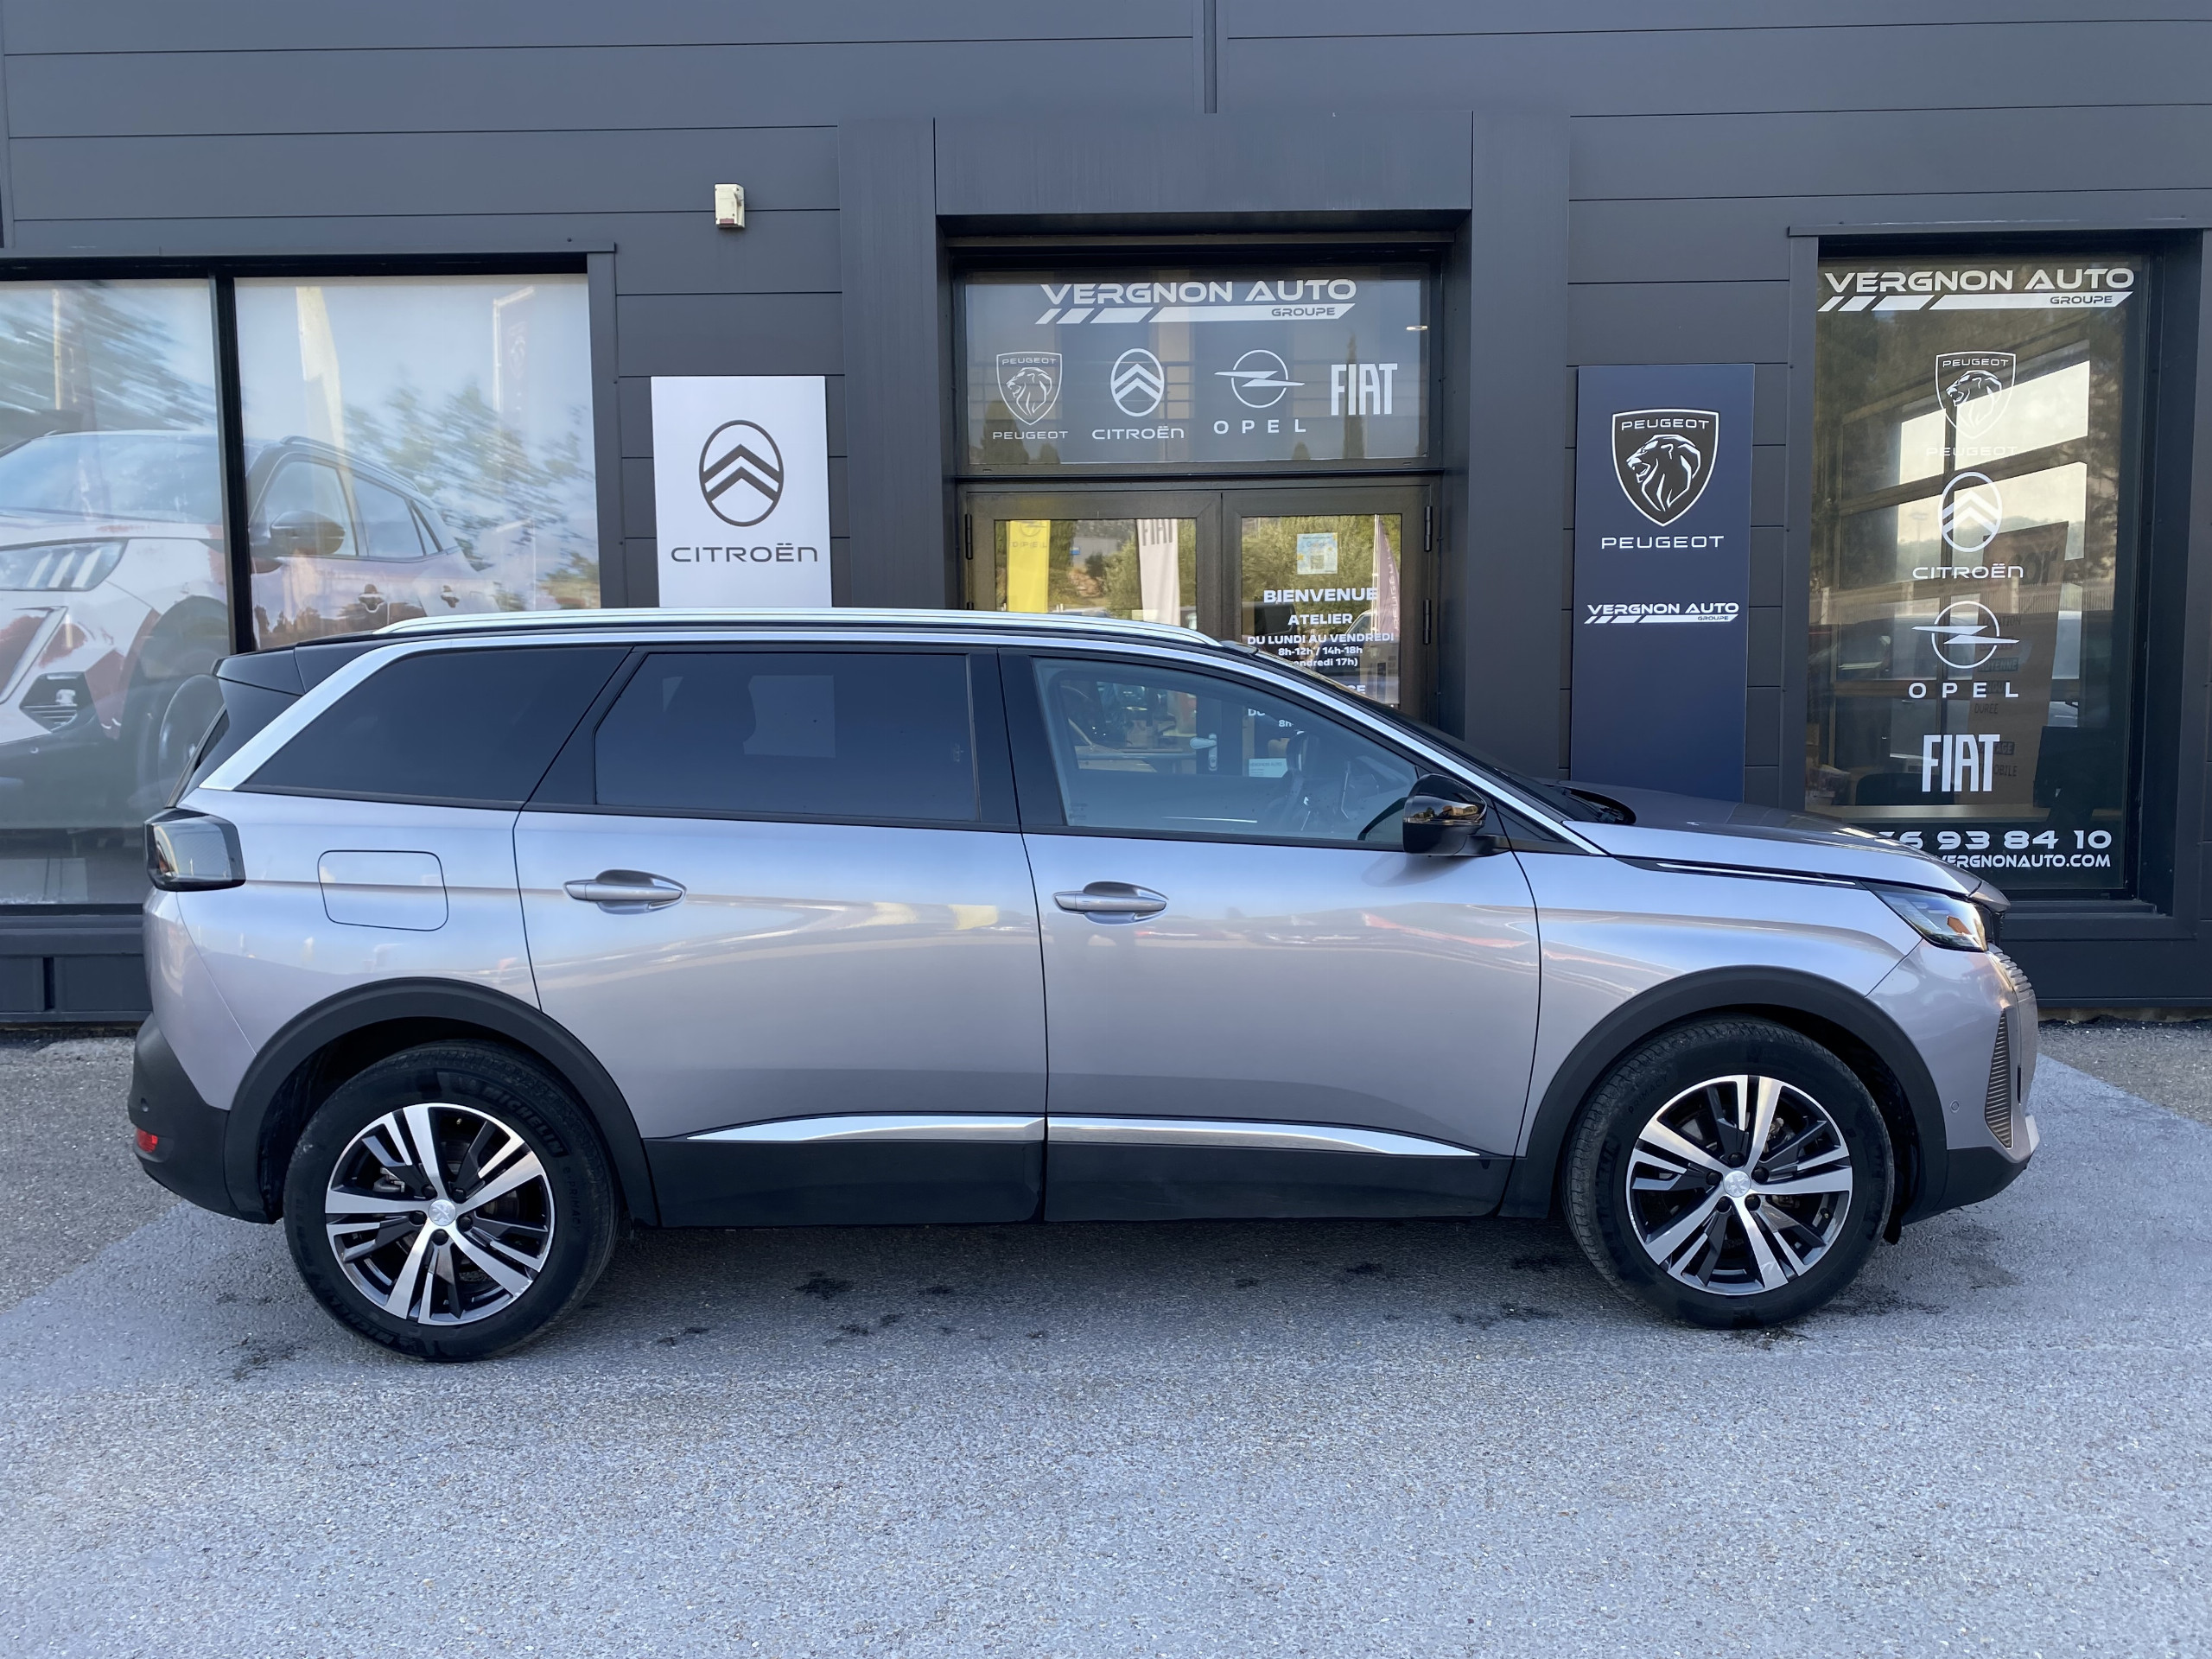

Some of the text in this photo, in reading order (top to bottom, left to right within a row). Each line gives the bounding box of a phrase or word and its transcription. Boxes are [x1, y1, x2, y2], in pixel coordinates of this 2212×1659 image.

[1825, 268, 2134, 293] VERGNON AUTO
[1041, 279, 1357, 305] VERGNON AUTO
[2050, 296, 2113, 304] GROUPE
[1271, 308, 1336, 317] GROUPE
[1001, 355, 1058, 366] PEUGEOT
[1942, 358, 2009, 368] PEUGEOT
[1331, 363, 1398, 416] FIAT
[1213, 418, 1306, 435] OPEL
[1621, 418, 1710, 431] PEUGEOT
[993, 430, 1069, 440] PEUGEOT
[1926, 446, 2018, 456] PEUGEOT
[1601, 535, 1725, 550] PEUGEOT
[1263, 588, 1378, 604] BIENVENUE
[1587, 603, 1739, 615] VERGNON AUTO
[1287, 613, 1353, 626] ATELIER
[1247, 632, 1395, 645] DU LUNDI AU VENDREDI
[1278, 645, 1363, 656] 8h-12h / 14h-18h
[1294, 658, 1358, 667] ndredi 17h)
[1908, 681, 2019, 699] OPEL
[1922, 734, 2000, 792] FIAT
[1878, 830, 2113, 850] 6 93 84 10
[482, 1086, 563, 1156] MICHELIN
